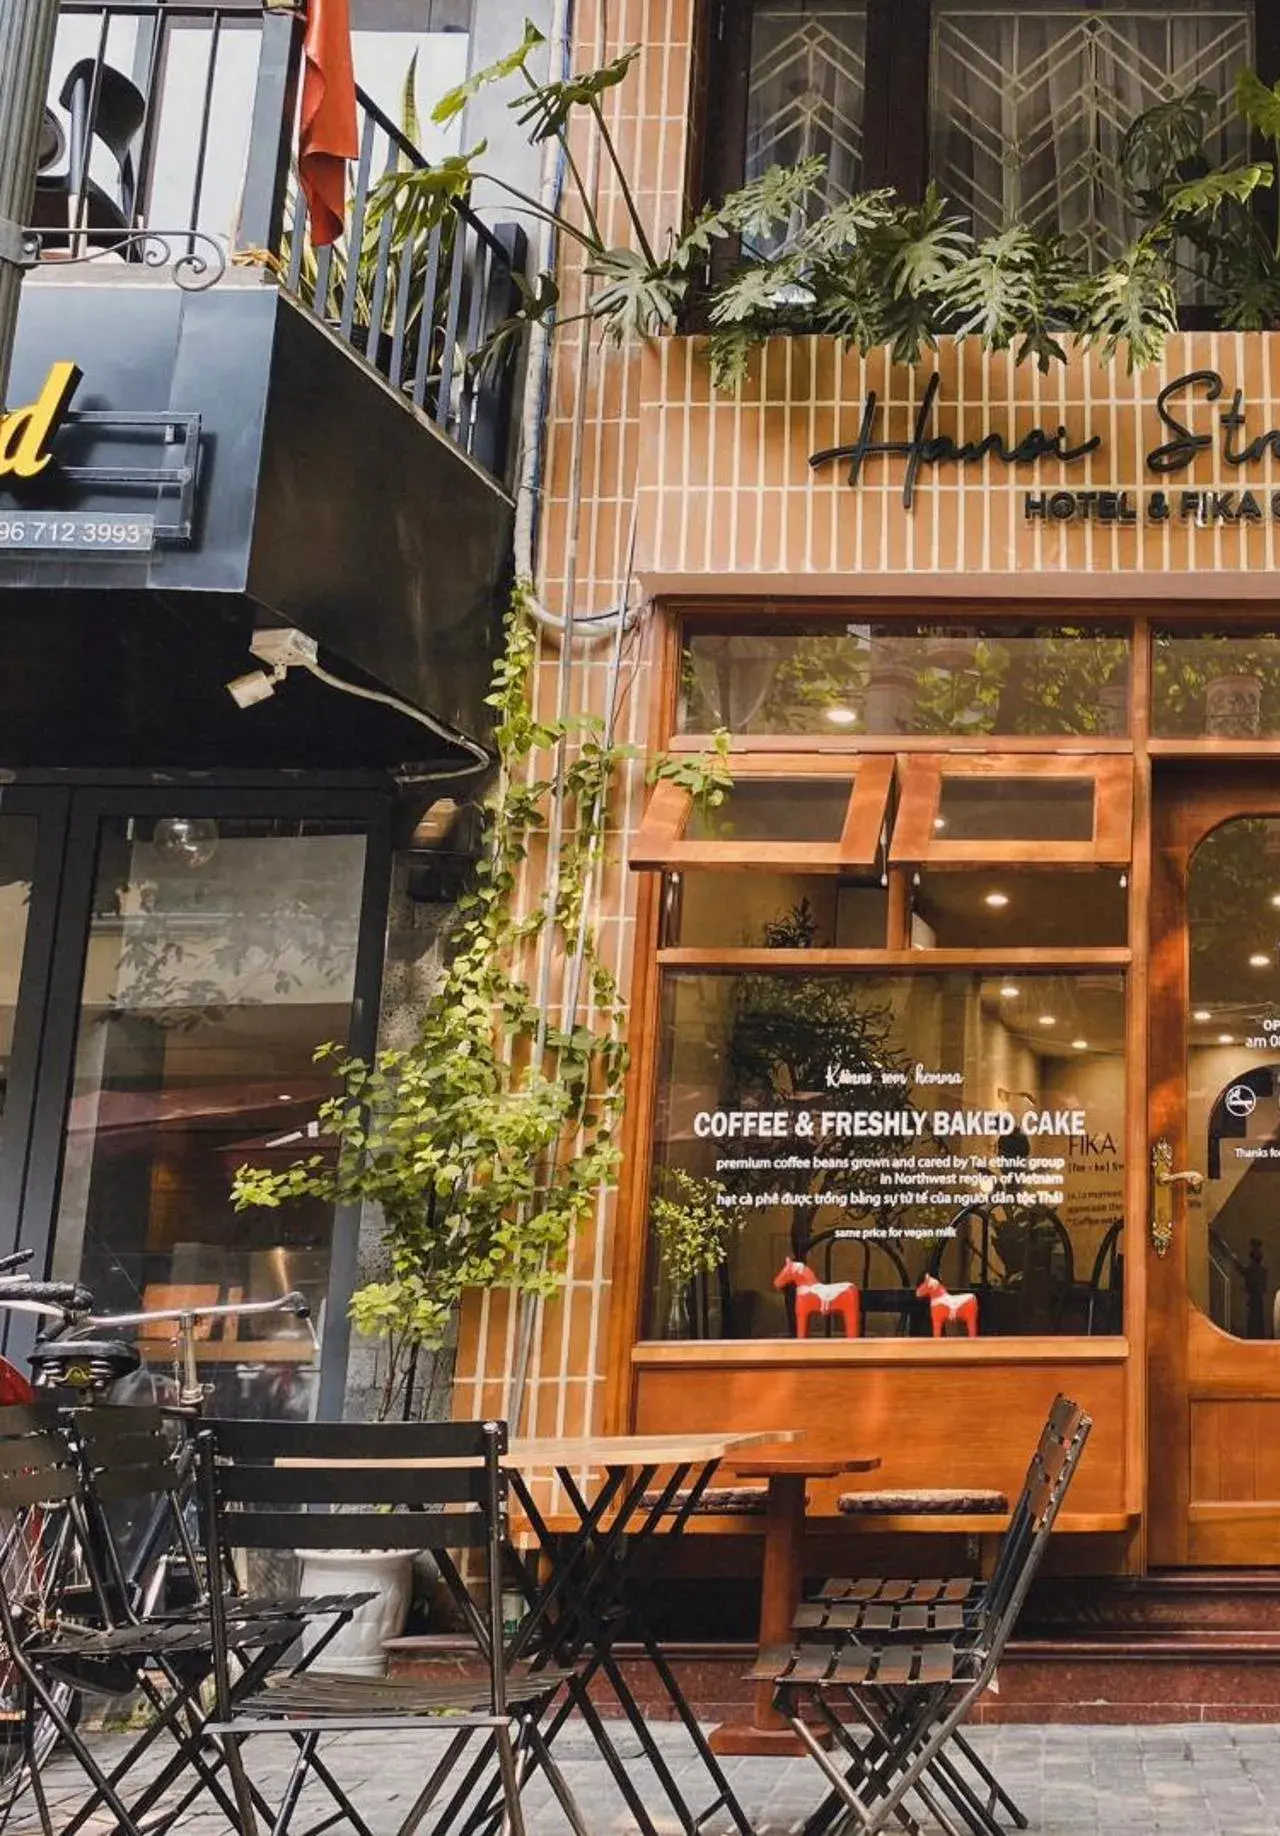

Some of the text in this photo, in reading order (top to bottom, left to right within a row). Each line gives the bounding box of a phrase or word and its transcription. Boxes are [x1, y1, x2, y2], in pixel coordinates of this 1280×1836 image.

[808, 372, 1100, 509] Hanoi
[1024, 490, 1136, 520] HOTEL
[1148, 491, 1170, 520] &
[1181, 491, 1262, 520] FIKA
[33, 521, 75, 542] 712
[83, 521, 142, 543] 3993
[1246, 1036, 1267, 1047] am
[693, 1110, 1086, 1137] COFFEE & FRESHLY BAKED CAKE
[1234, 1147, 1268, 1159] Thanks
[716, 1155, 1065, 1172] premium coffee beans grown and cared by Tai ethnic group
[880, 1172, 1064, 1188] in Northwest region of Vietnam
[716, 1192, 737, 1207] hạt
[739, 1191, 753, 1205] cà
[755, 1191, 779, 1208] phê
[834, 1229, 861, 1238] same
[862, 1227, 887, 1240] price
[888, 1226, 902, 1238] for
[903, 1228, 934, 1240] vegan
